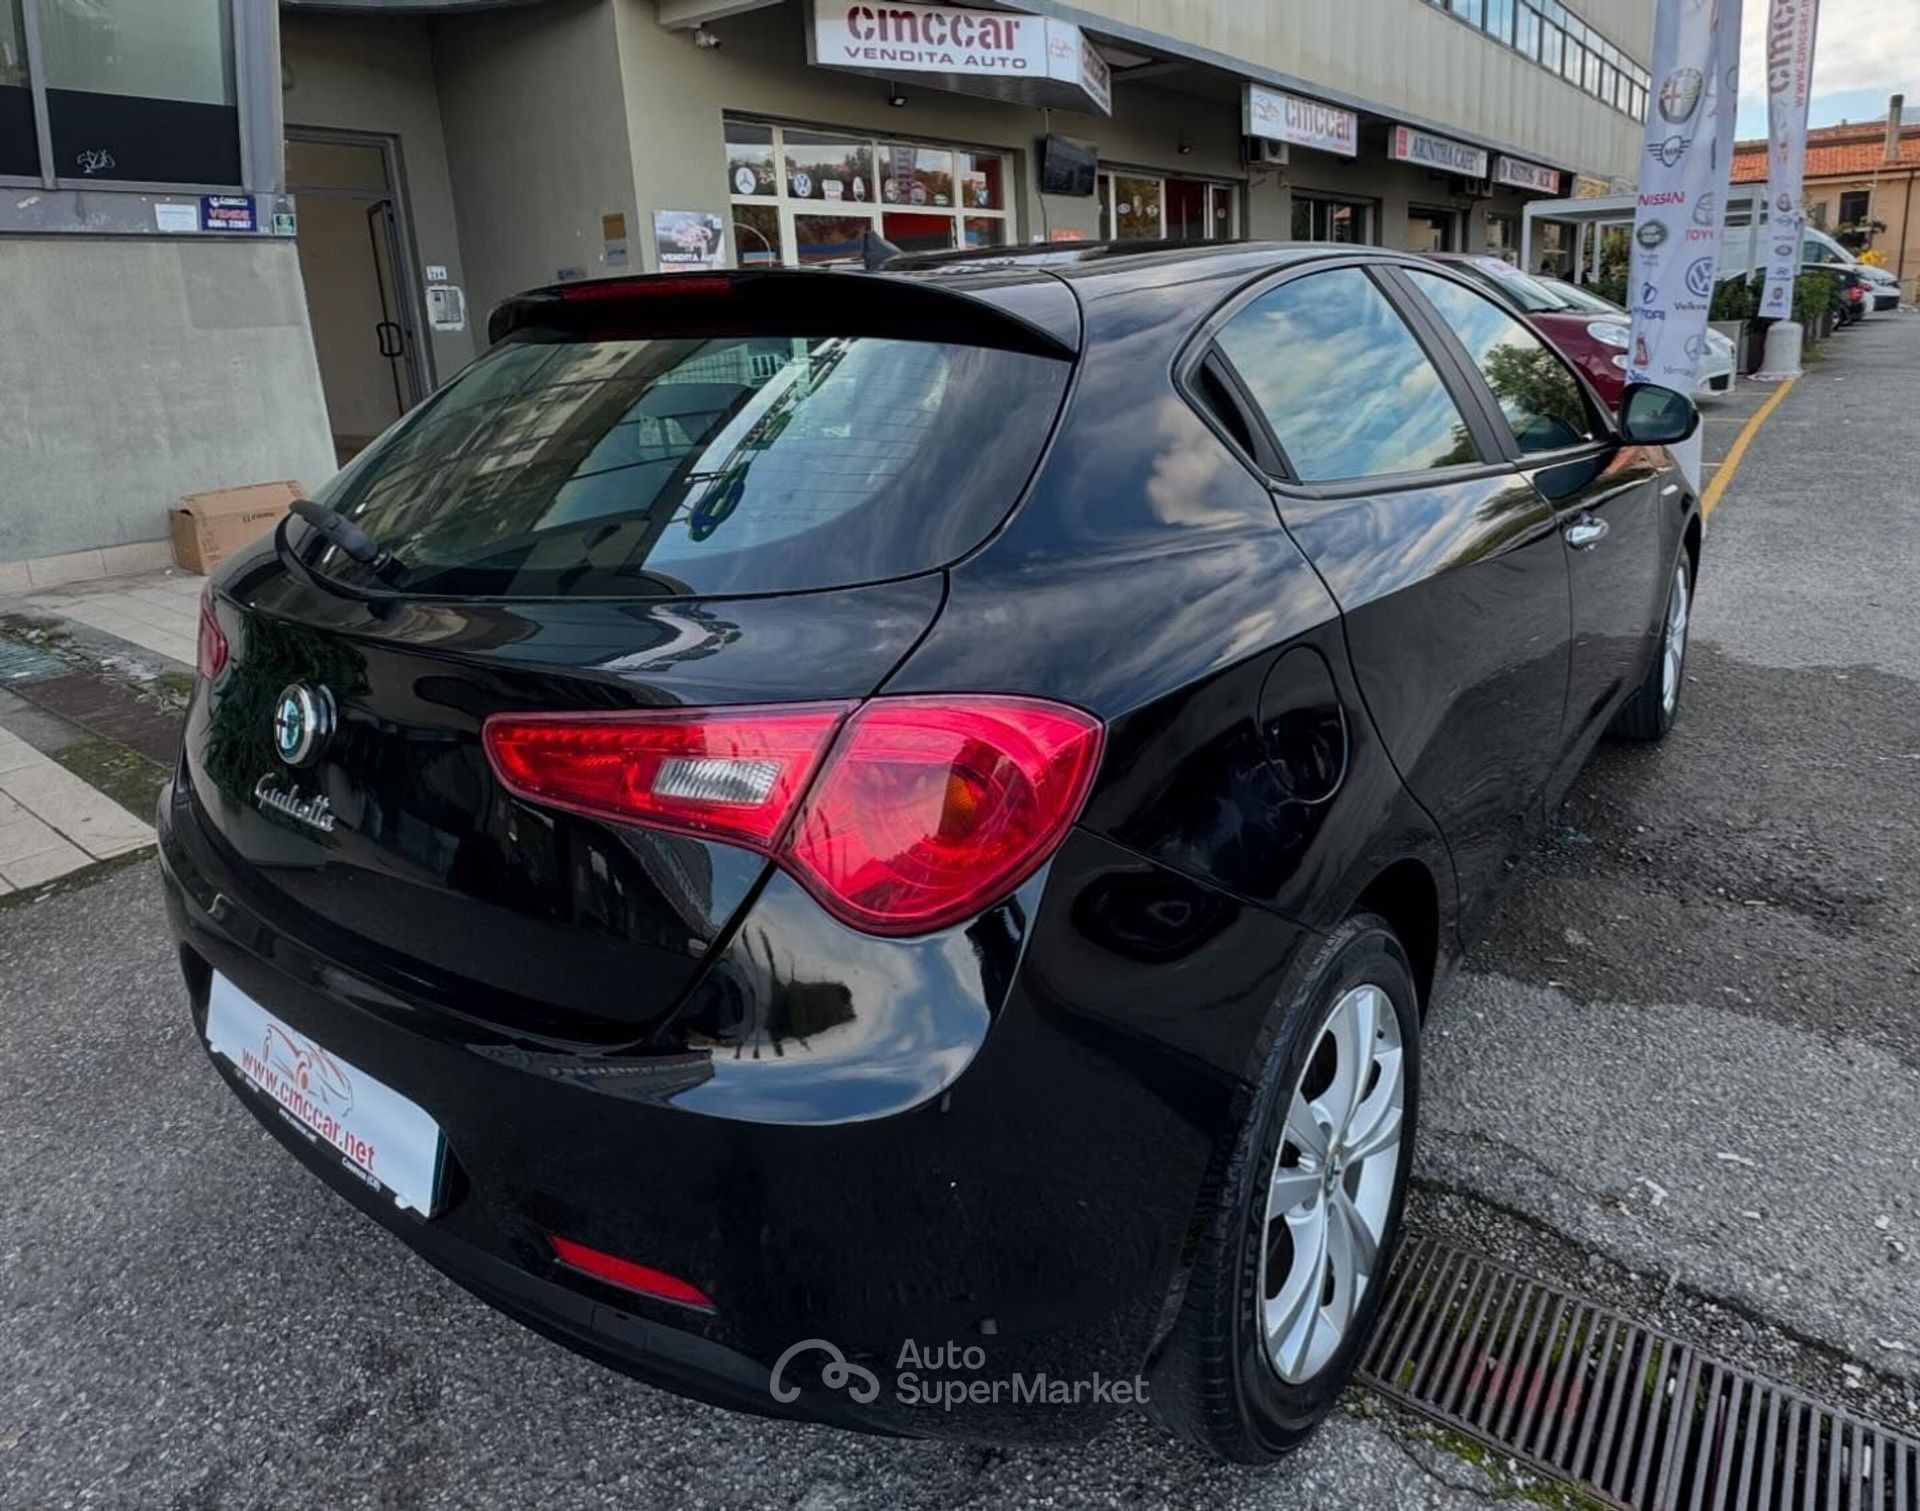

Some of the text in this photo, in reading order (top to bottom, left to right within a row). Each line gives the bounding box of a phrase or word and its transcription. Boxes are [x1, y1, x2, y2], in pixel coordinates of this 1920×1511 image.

[847, 5, 1021, 51] cmccar
[844, 46, 1028, 70] VENDITA AUTO
[1769, 0, 1795, 94] cmc
[1637, 191, 1685, 206] NISSAN
[1685, 228, 1713, 241] TOY
[241, 1046, 376, 1172] www.cmccar.net
